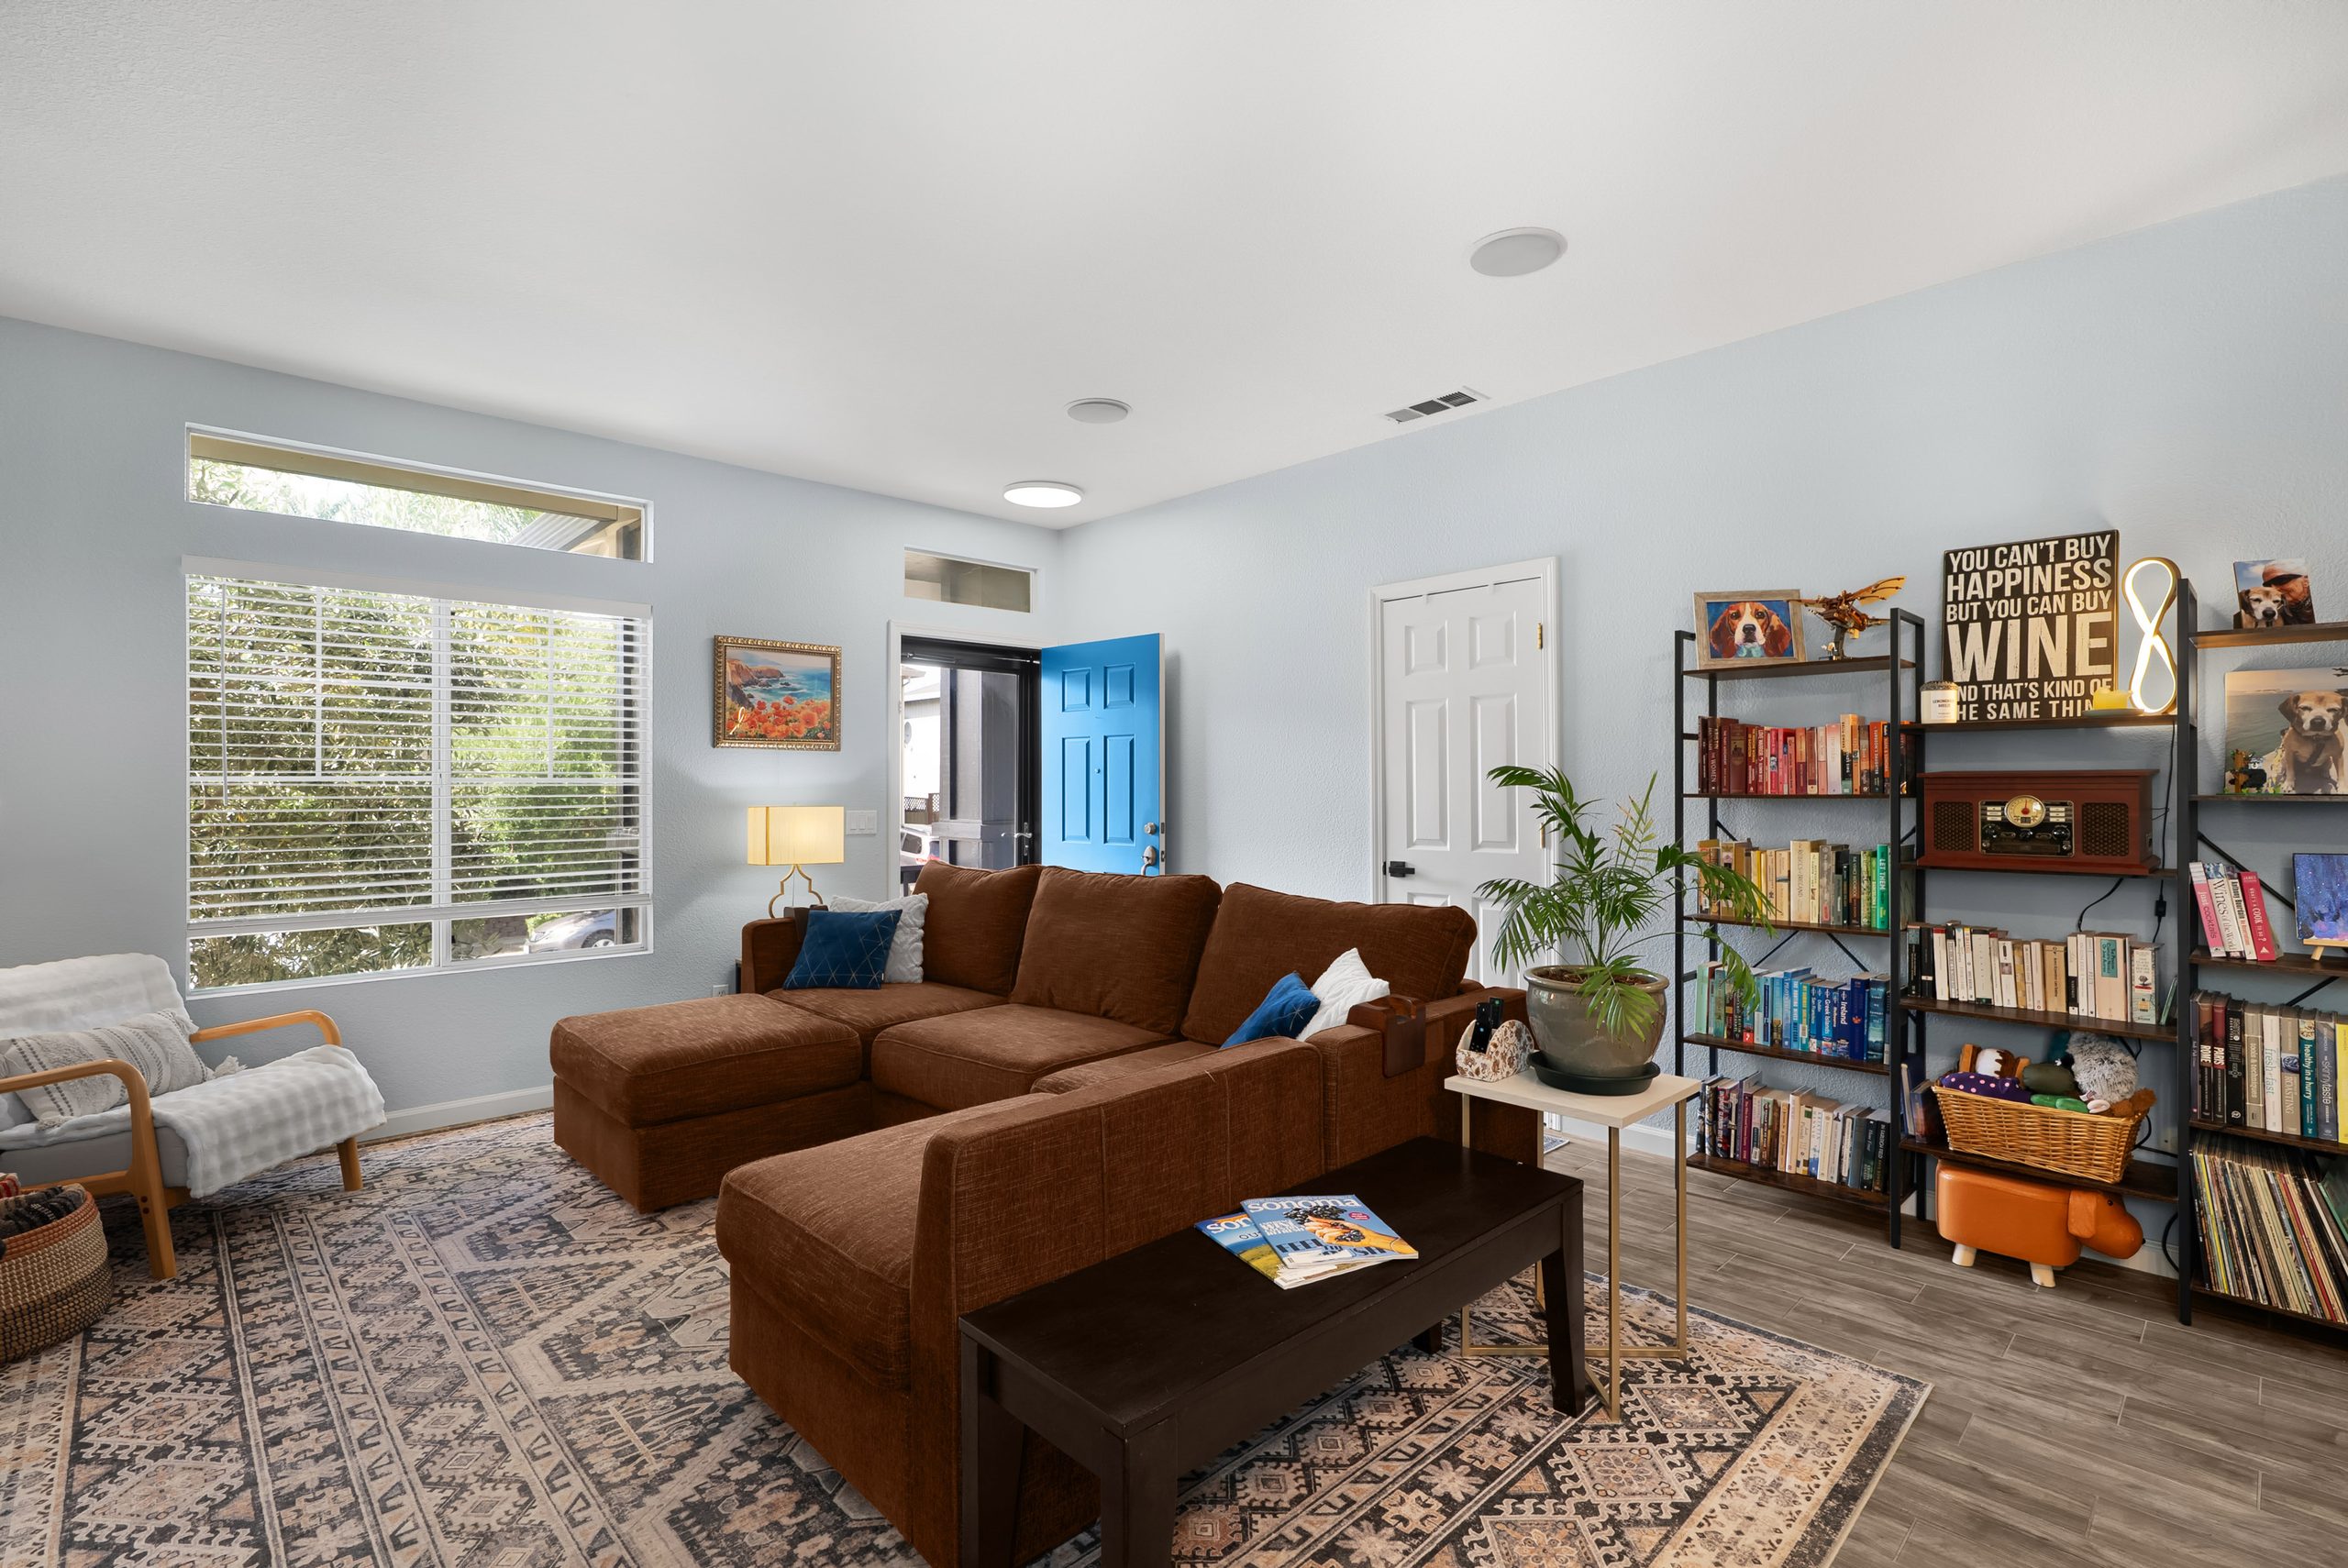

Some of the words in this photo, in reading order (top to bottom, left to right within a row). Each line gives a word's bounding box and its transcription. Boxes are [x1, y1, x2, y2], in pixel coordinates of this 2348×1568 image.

[1949, 548, 1988, 573] YOU
[1995, 540, 2058, 569] CAN'T
[2066, 534, 2110, 561] BUY
[1947, 558, 2112, 602] HAPPINESS
[1946, 602, 1981, 623] BUT
[1986, 598, 2021, 619] YOU
[2027, 593, 2066, 616] CAN
[2072, 590, 2112, 613] BUY
[1947, 611, 2112, 683] WINE
[1956, 684, 1977, 702] ND
[1982, 681, 2039, 701] THAT'S
[2043, 679, 2085, 698] KIND
[2089, 678, 2112, 696] OF
[1957, 703, 1978, 721] HE
[1987, 701, 2041, 720] SAME
[2212, 879, 2231, 915] Wines
[2231, 881, 2242, 900] Anthony
[2198, 890, 2208, 906] just
[2203, 906, 2218, 939] cocktails
[2221, 915, 2230, 923] of
[2233, 899, 2246, 920] Bourdain
[2251, 907, 2263, 924] COOK
[2222, 923, 2232, 933] the
[2225, 933, 2238, 951] World
[1840, 1001, 1848, 1025] Ireland
[2200, 1042, 2211, 1060] ROME
[2213, 1043, 2225, 1063] PARIS
[2265, 1048, 2276, 1071] fresh
[2303, 1043, 2313, 1069] healthy
[2249, 1064, 2258, 1099] techniques
[2265, 1077, 2277, 1095] fast
[2304, 1081, 2314, 1099] hurry
[2320, 1061, 2332, 1104] skinnytaste
[2285, 1076, 2294, 1114] ROASTING
[1247, 1198, 1361, 1214] sonoma
[1206, 1217, 1252, 1235] son
